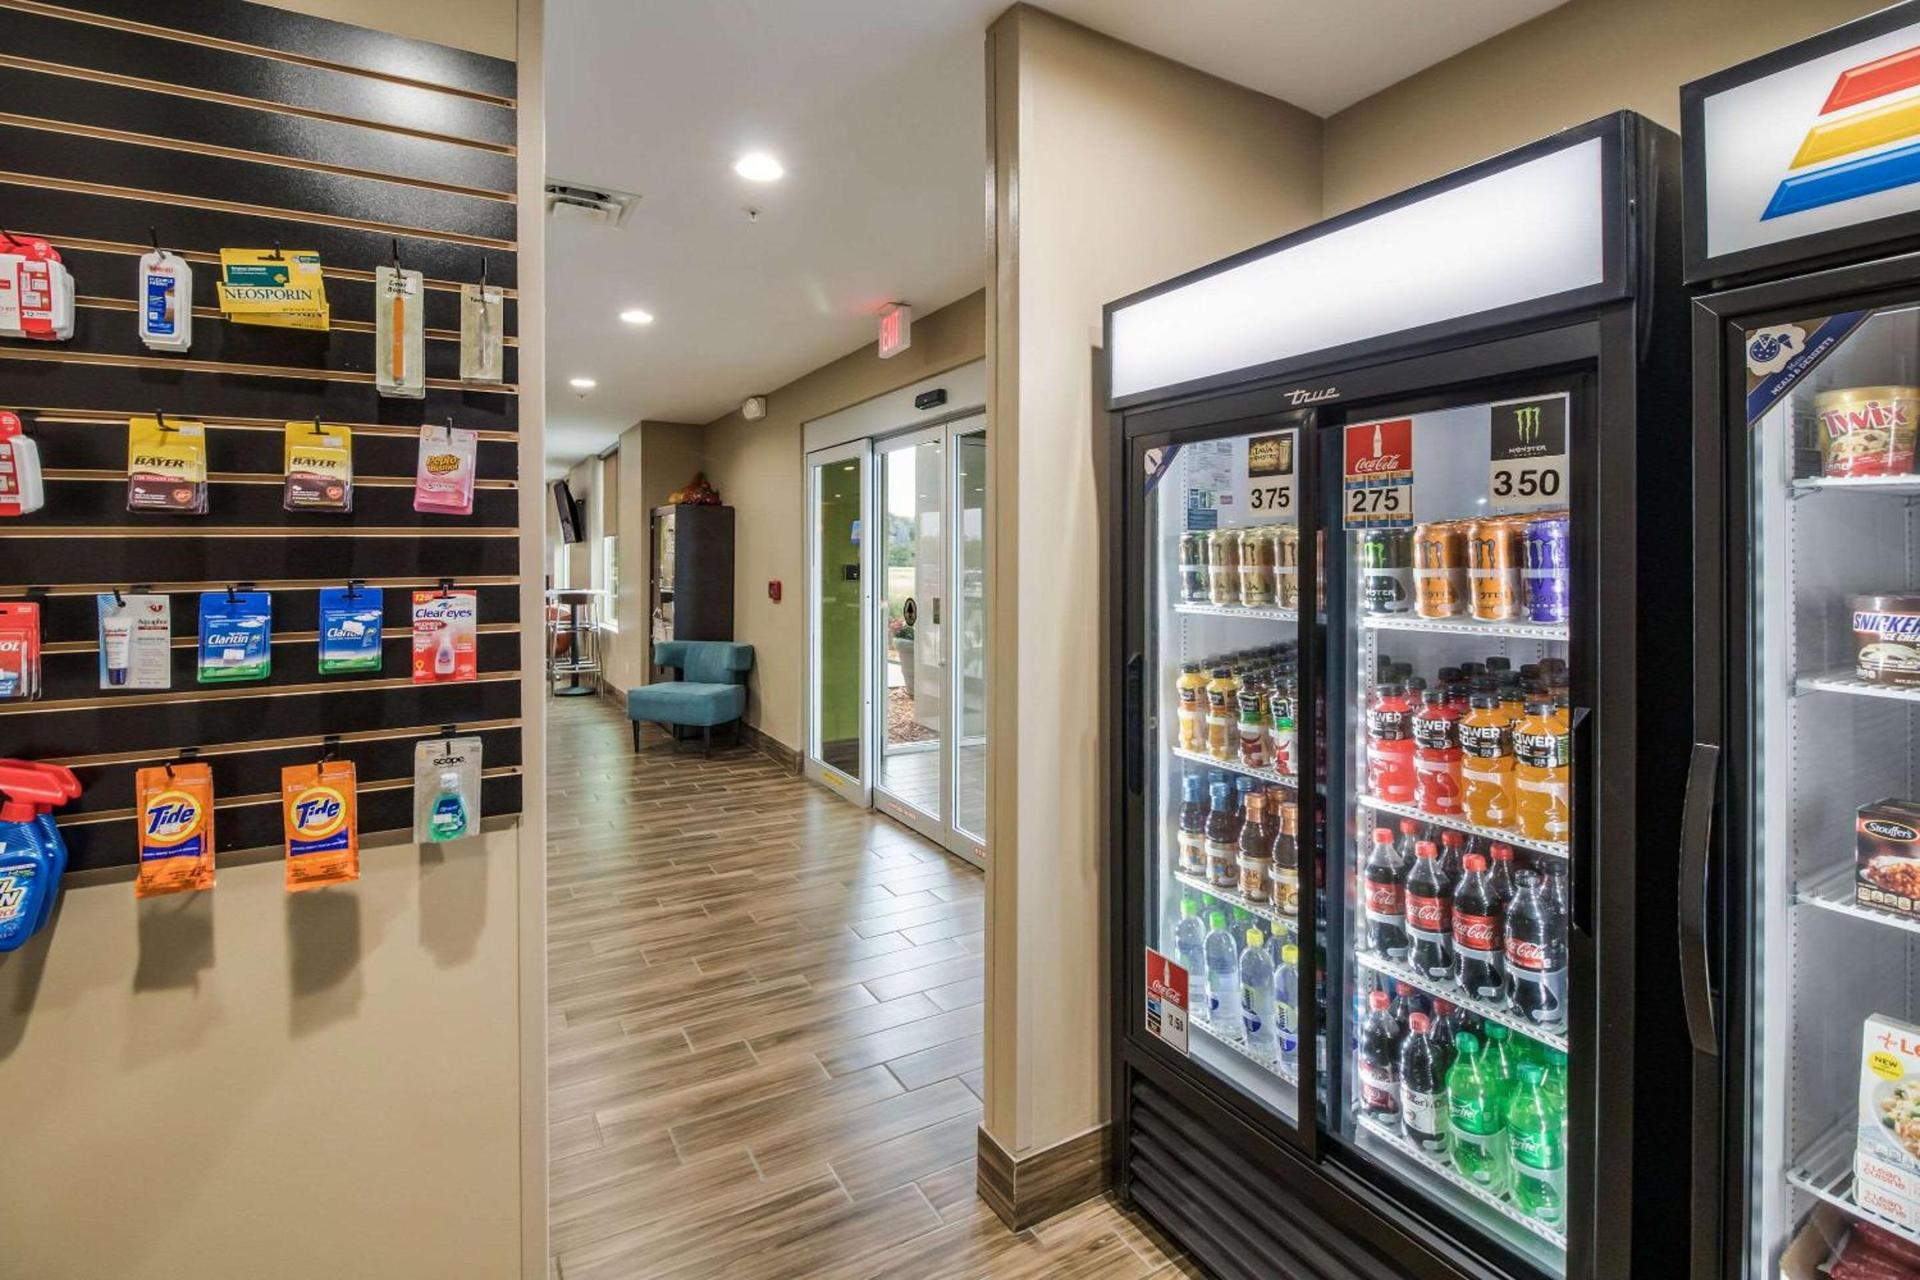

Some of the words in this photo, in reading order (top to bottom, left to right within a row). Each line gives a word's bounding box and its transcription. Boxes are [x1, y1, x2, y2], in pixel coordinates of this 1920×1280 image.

[224, 288, 312, 300] NEOSPORIN
[1508, 444, 1547, 454] MONSTER
[134, 455, 185, 468] BAYER
[292, 457, 337, 468] BAYER
[415, 608, 444, 618] Clear
[446, 609, 472, 619] eyes
[208, 631, 250, 645] Claritin
[433, 756, 465, 766] scope
[148, 803, 195, 834] Tide
[296, 799, 340, 829] Tide
[1869, 822, 1913, 839] Stouffer's
[1874, 1055, 1898, 1068] NEW
